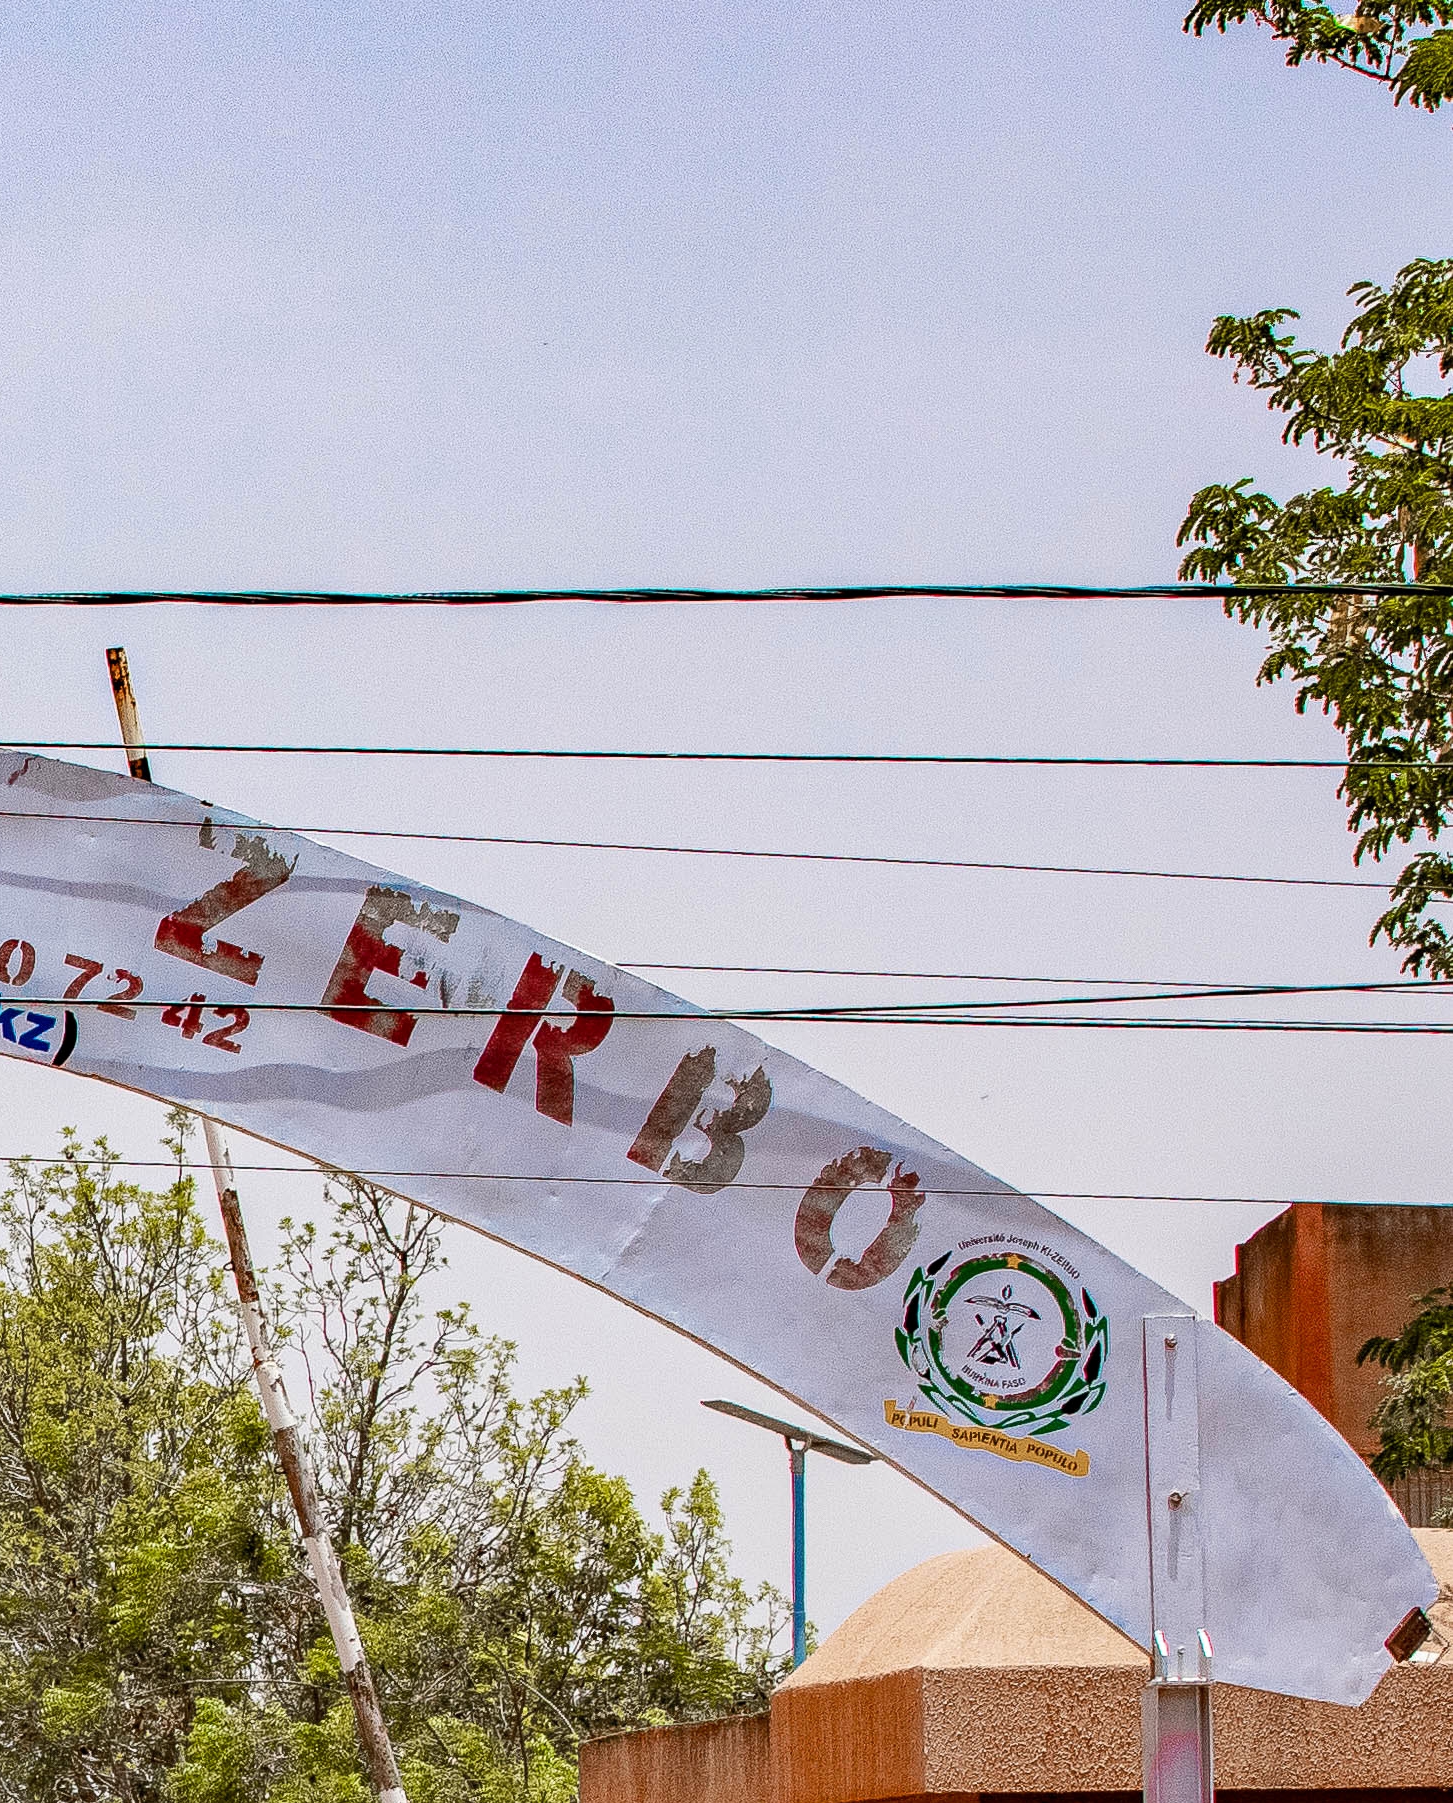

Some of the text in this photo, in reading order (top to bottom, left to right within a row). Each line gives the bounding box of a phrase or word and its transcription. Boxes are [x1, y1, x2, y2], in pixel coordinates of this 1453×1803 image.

[62, 952, 144, 1022] 72
[160, 992, 251, 1055] 42
[155, 818, 926, 1291] ZERBO
[951, 1427, 1018, 1454] SAPIENTIA
[1027, 1444, 1078, 1472] POPULO
